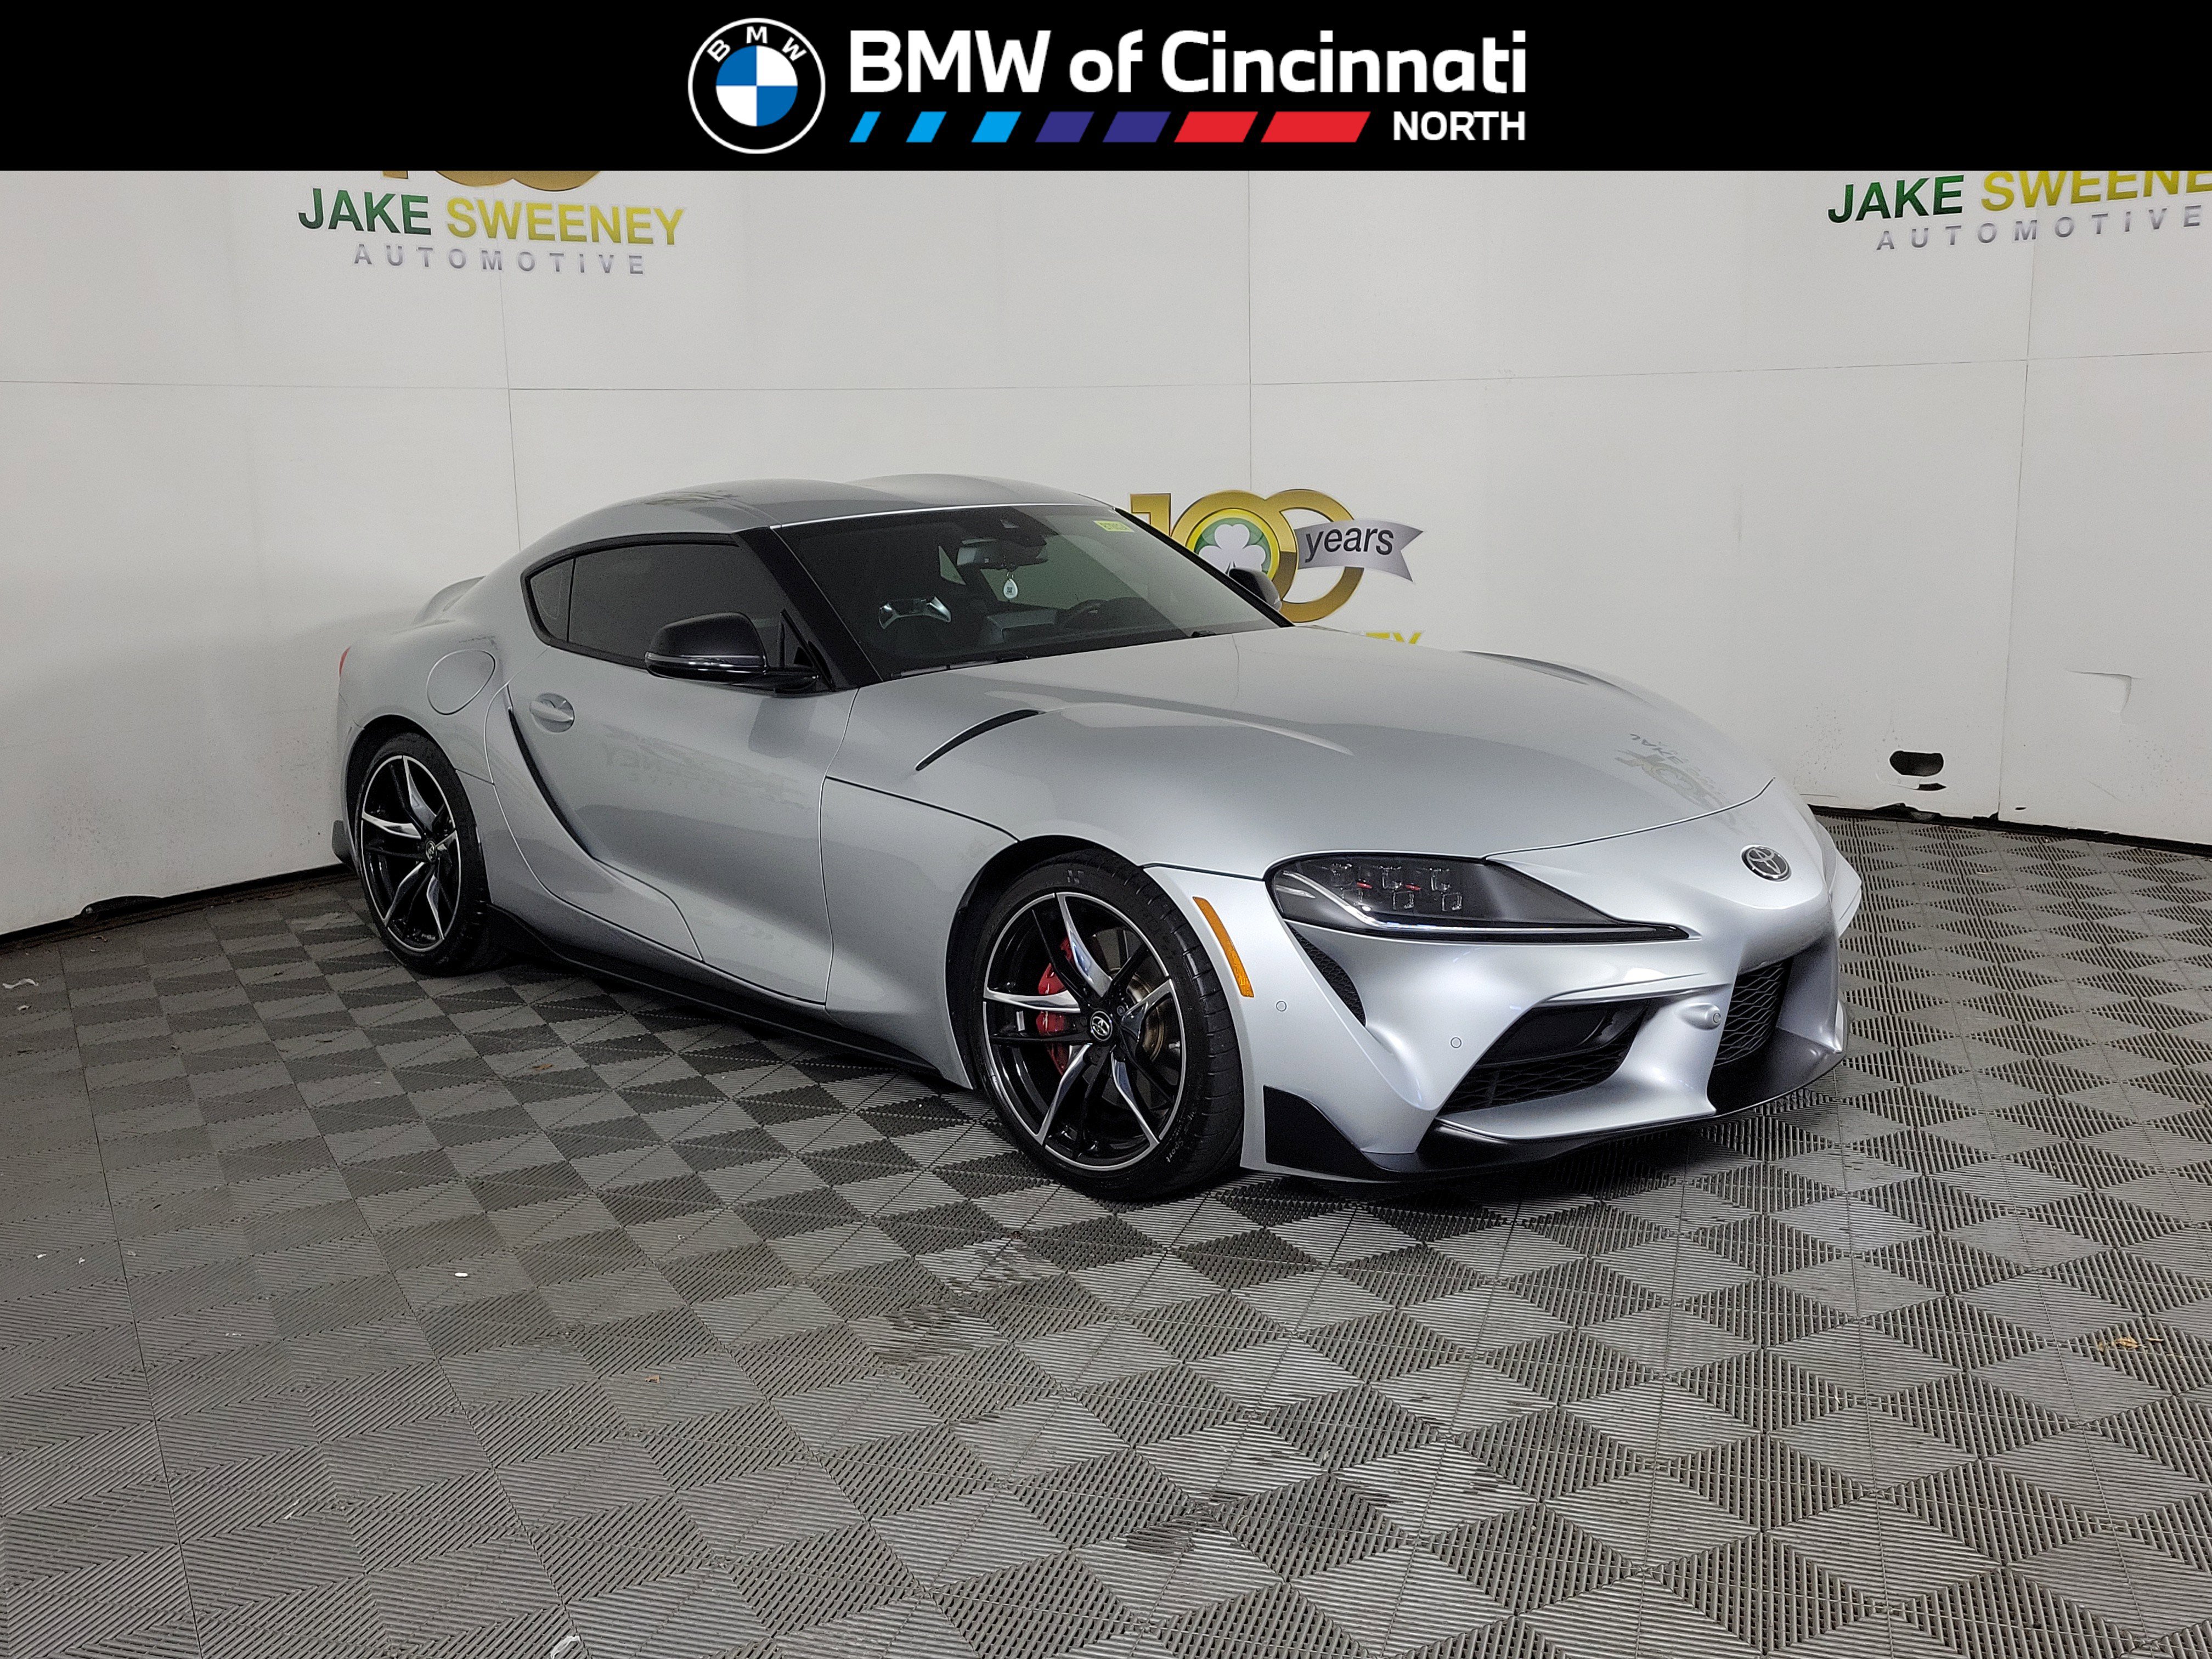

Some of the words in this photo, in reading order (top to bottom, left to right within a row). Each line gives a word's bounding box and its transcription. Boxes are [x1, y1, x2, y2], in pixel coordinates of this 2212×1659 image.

[298, 188, 432, 235] JAKE
[446, 197, 685, 245] SWEENEY
[1827, 174, 1965, 223] JAKE
[1875, 205, 2202, 251] AUTOMOTIVE
[353, 243, 645, 275] AUTOMOTIVE
[1305, 528, 1394, 564] years
